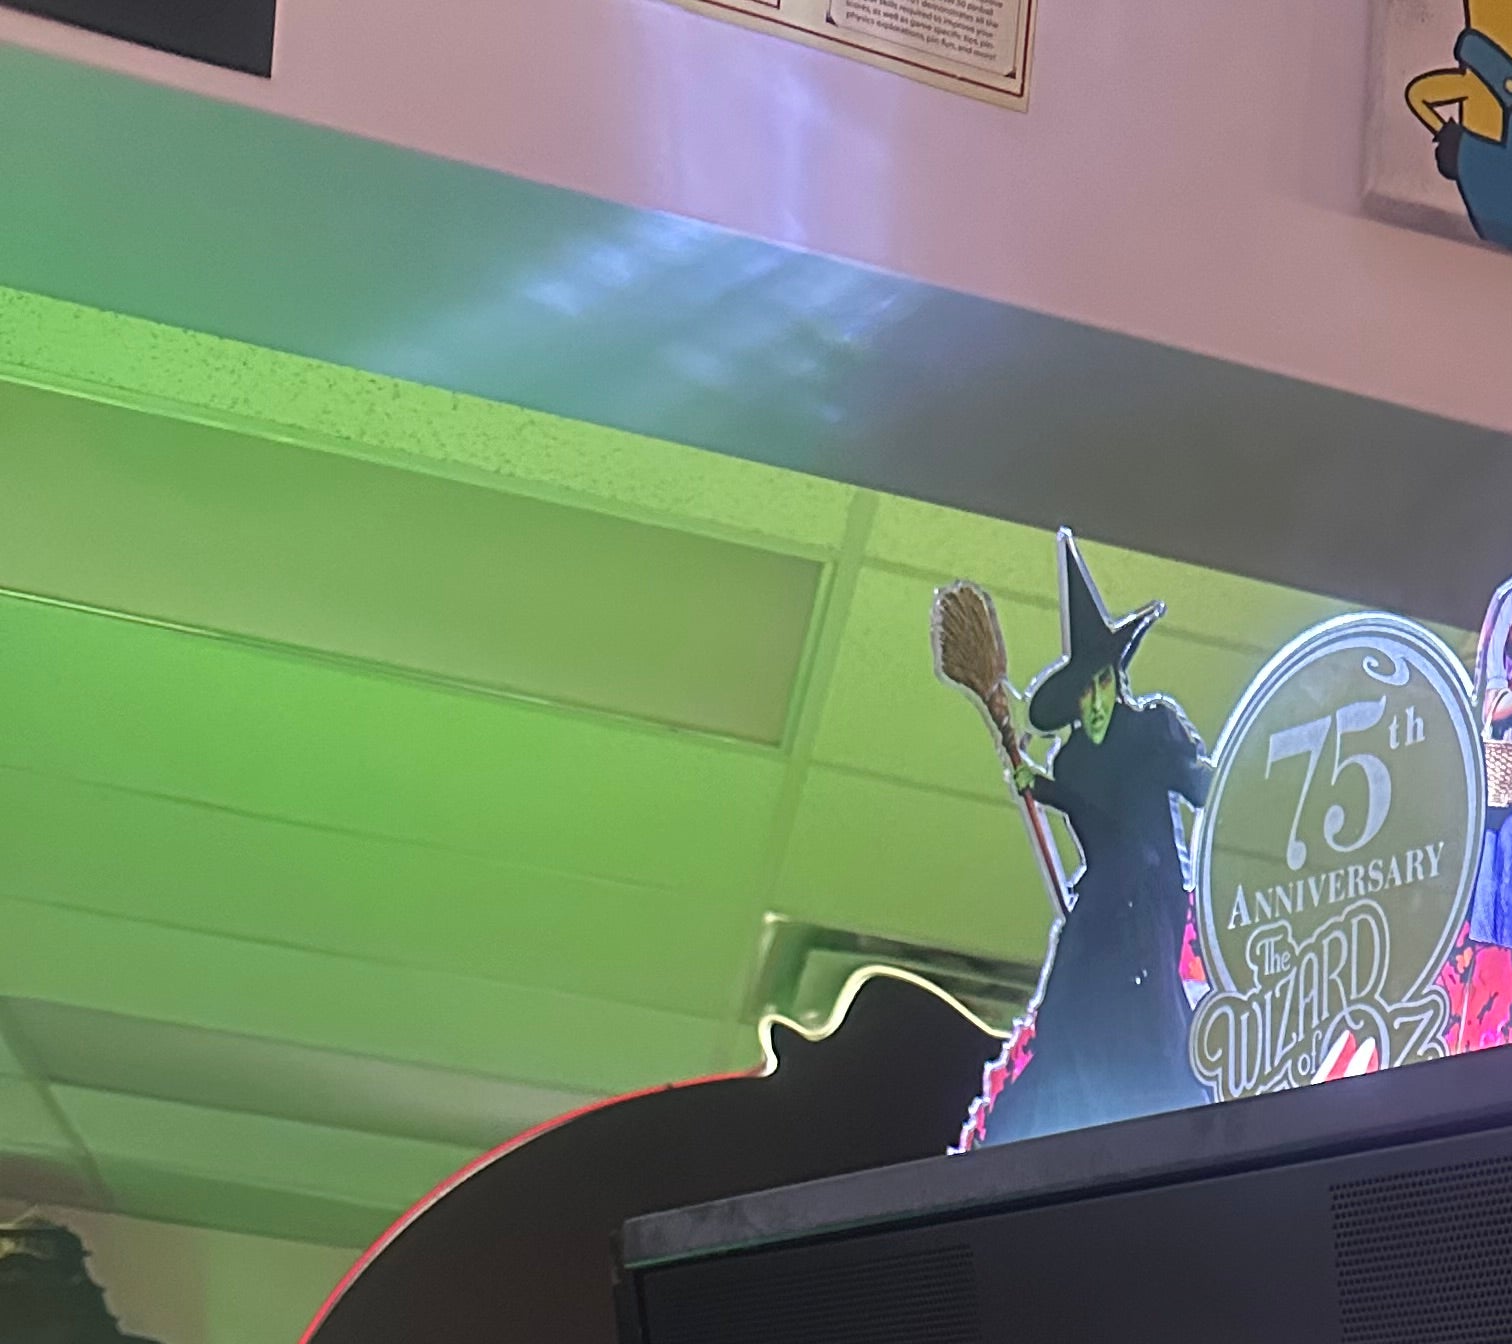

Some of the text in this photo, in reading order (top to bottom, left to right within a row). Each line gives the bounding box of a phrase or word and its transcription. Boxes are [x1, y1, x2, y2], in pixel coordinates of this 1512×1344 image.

[1227, 842, 1444, 930] ANNIVERSARY
[1260, 937, 1291, 976] The
[1203, 915, 1382, 1093] WIZARD
[1299, 1030, 1325, 1075] of
